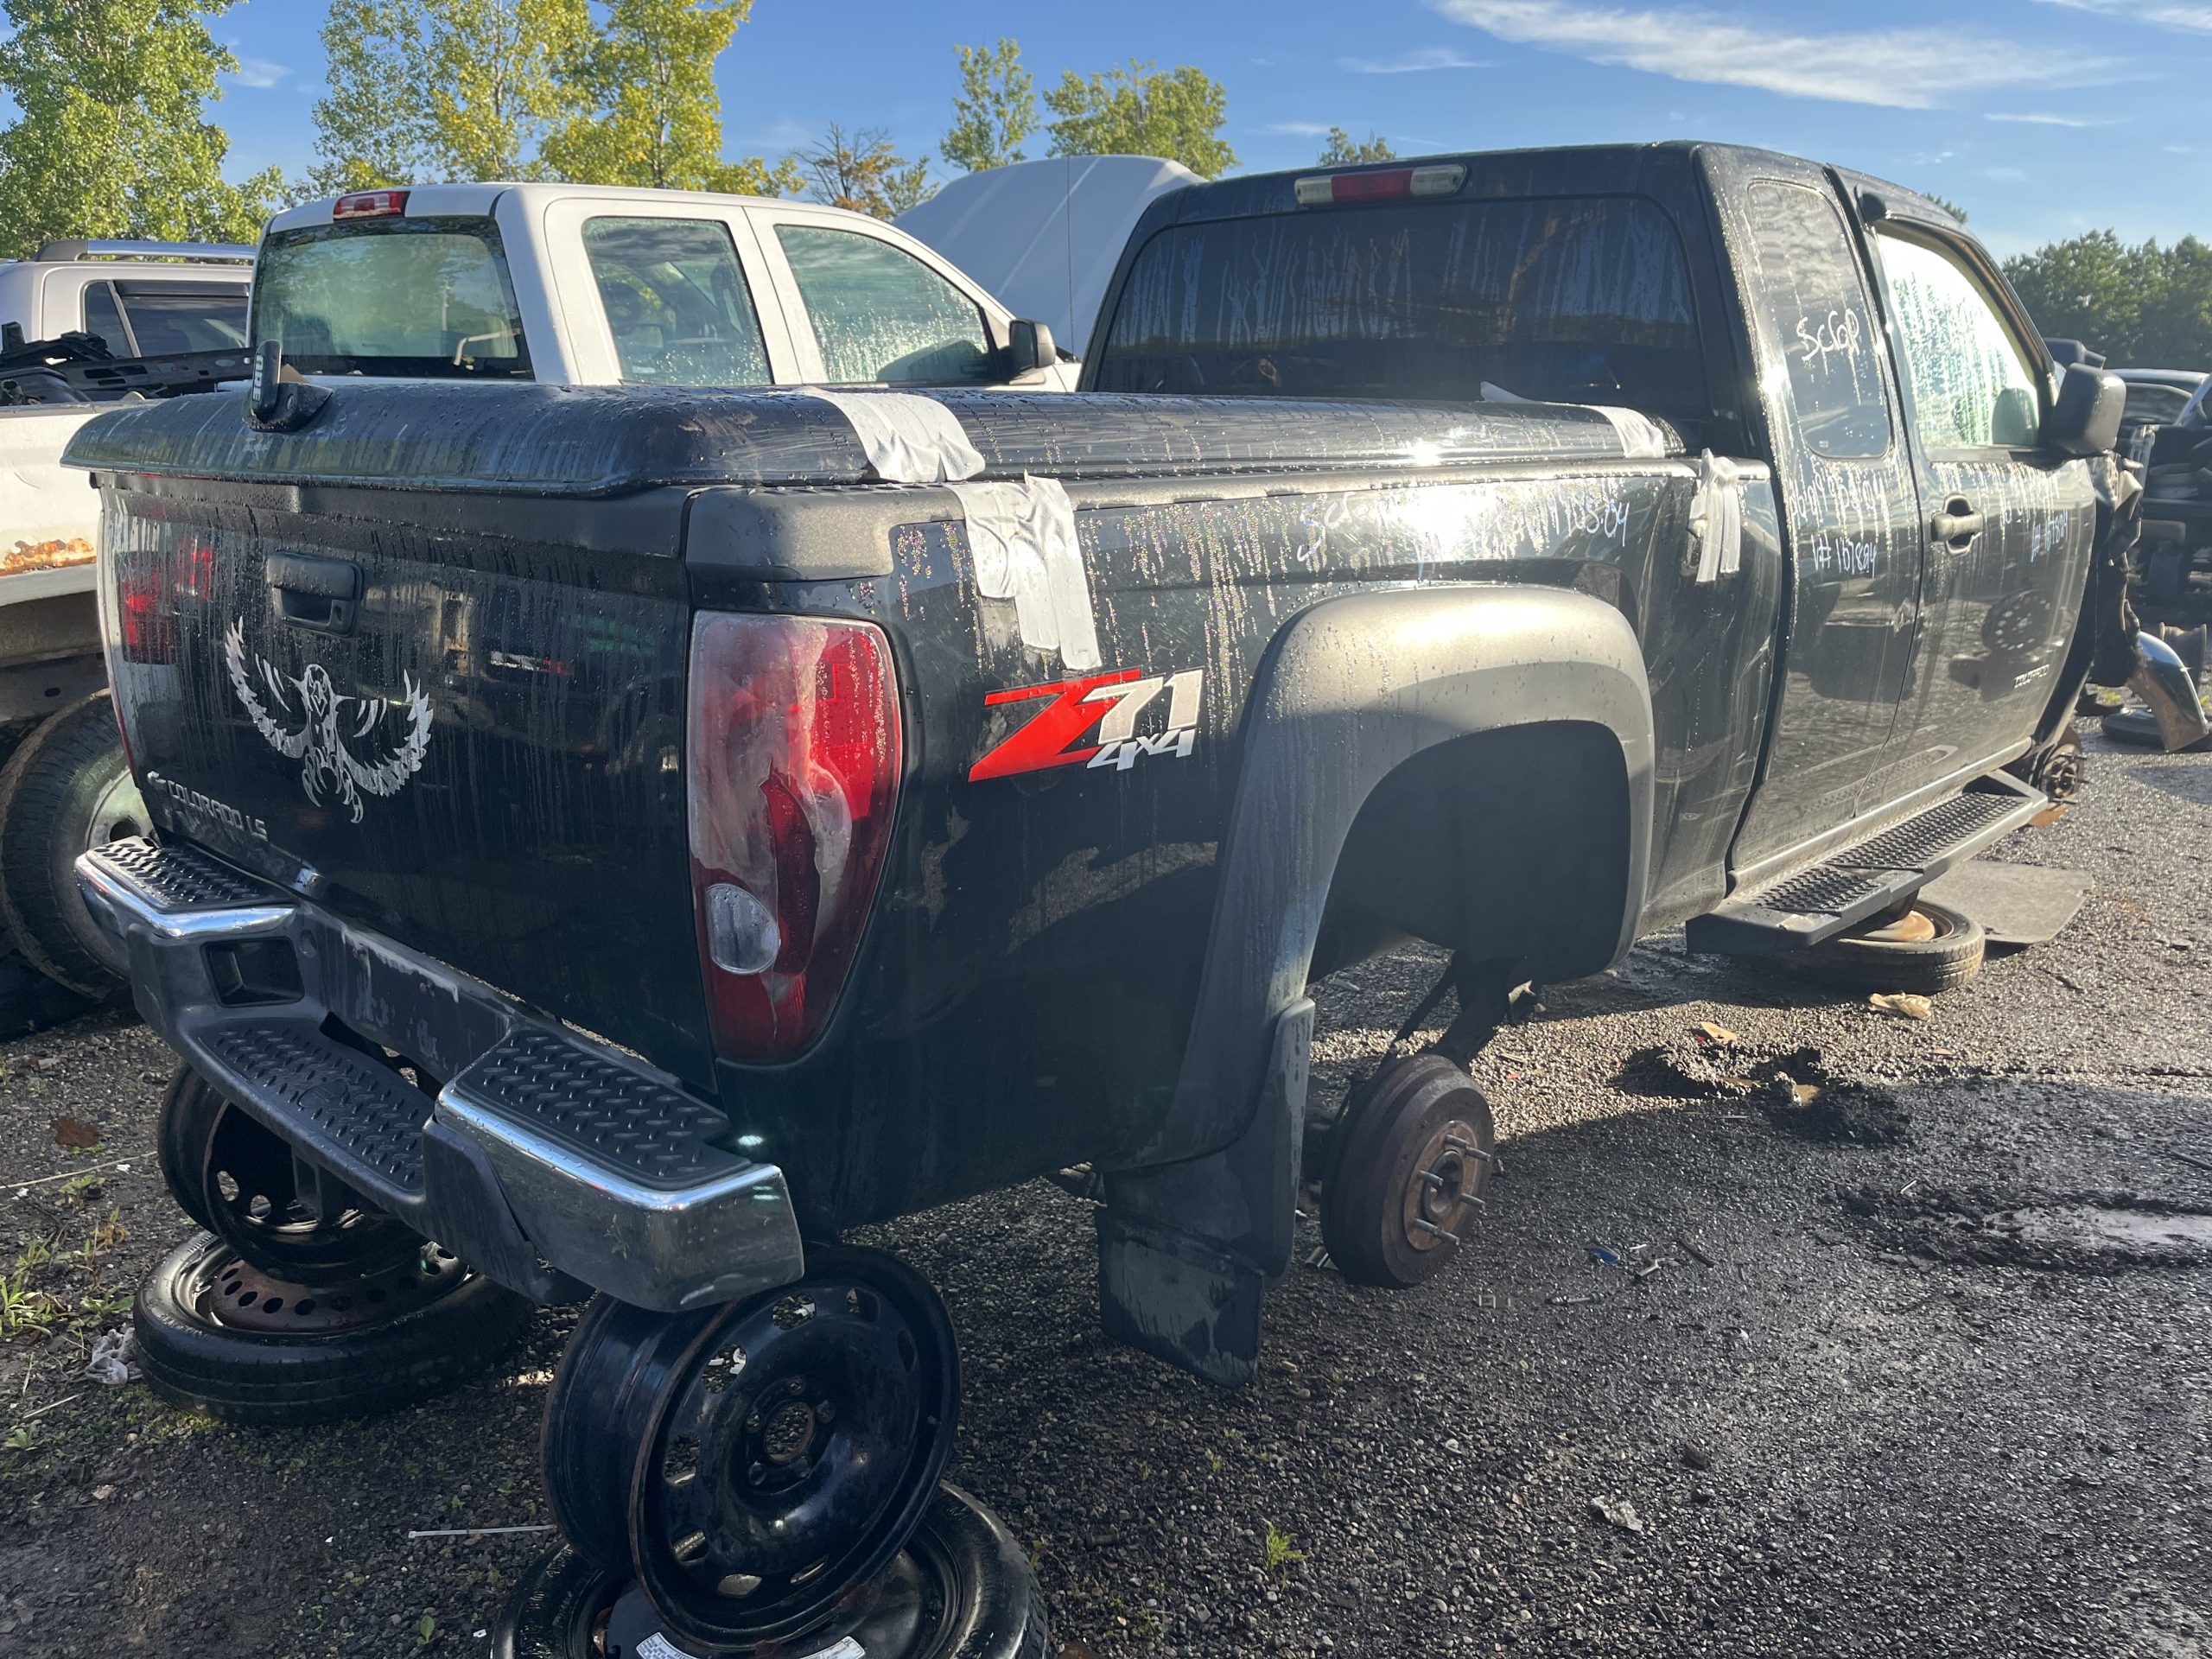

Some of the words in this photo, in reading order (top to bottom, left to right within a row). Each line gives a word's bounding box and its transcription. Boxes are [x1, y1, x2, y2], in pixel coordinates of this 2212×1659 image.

[969, 666, 1205, 783] Z71
[1086, 728, 1198, 772] 4x4
[166, 779, 245, 832] COLORADO
[245, 815, 269, 842] LS
